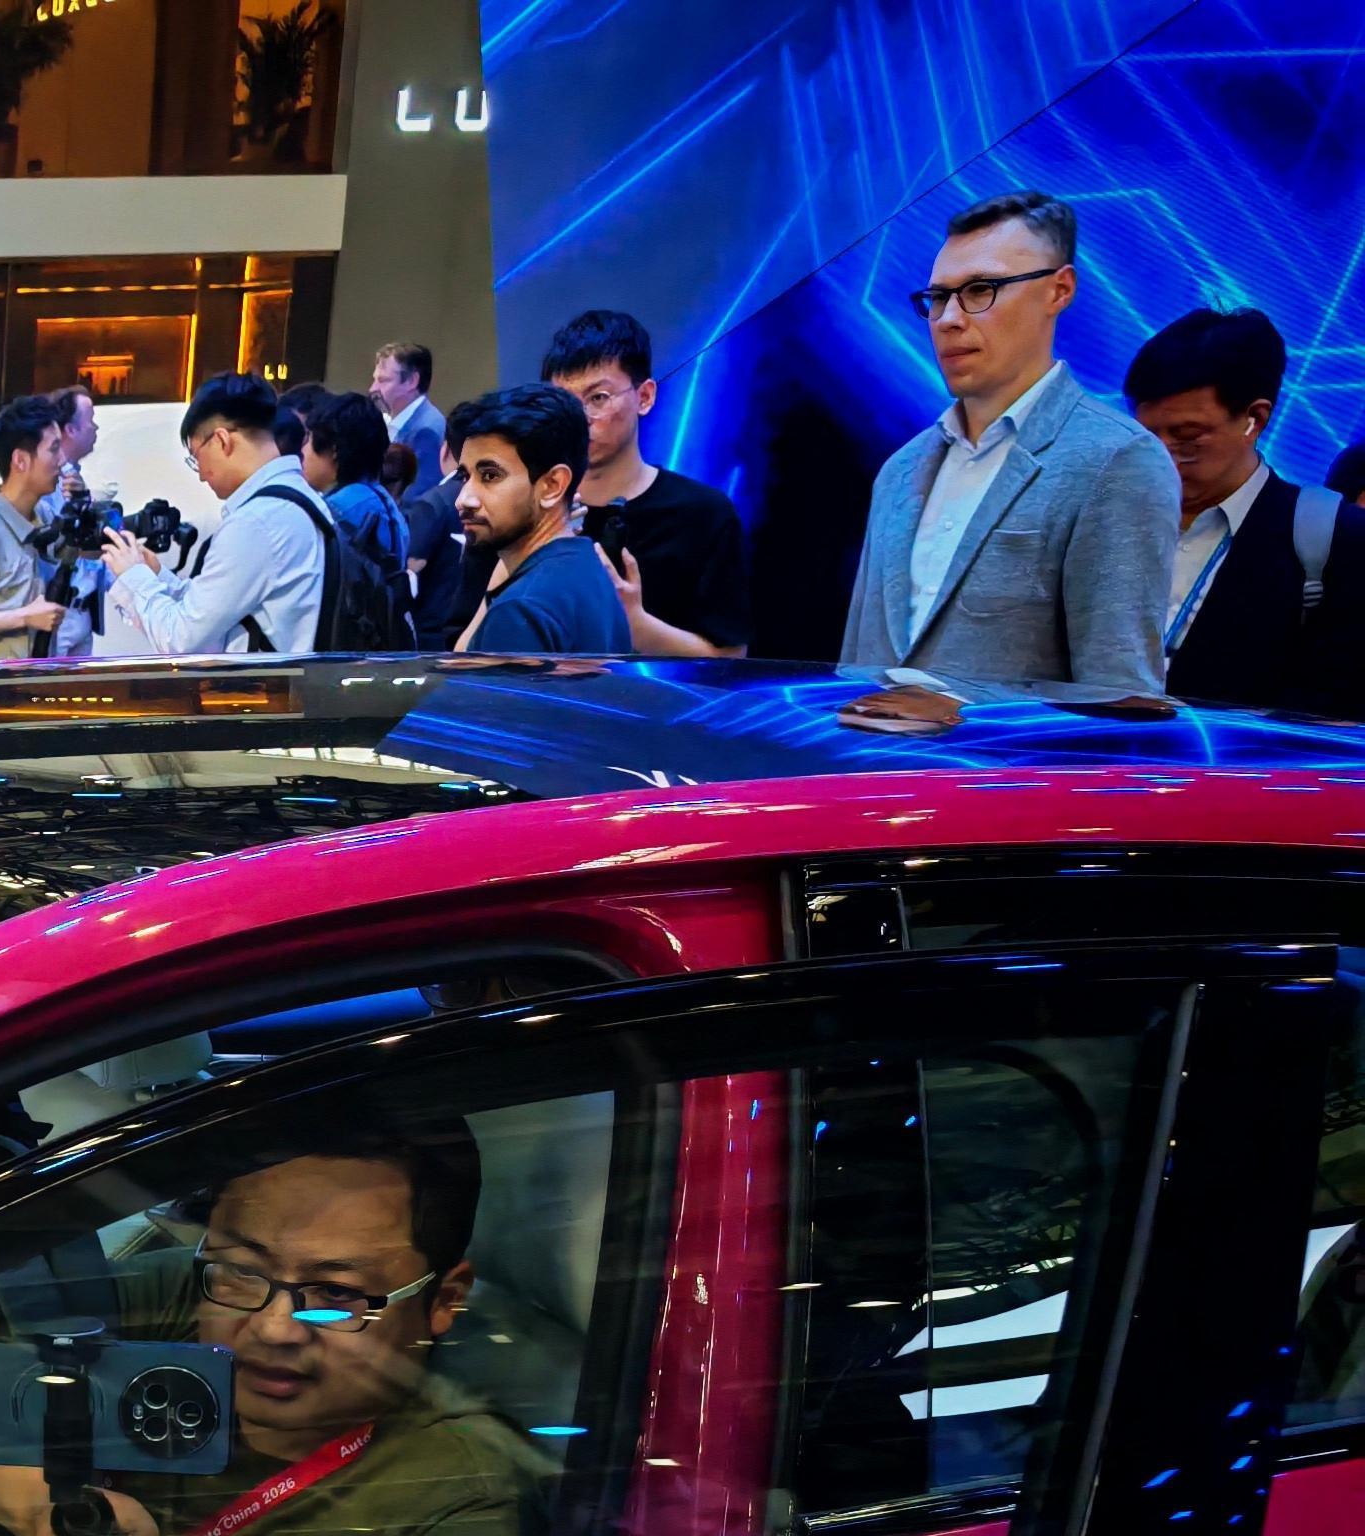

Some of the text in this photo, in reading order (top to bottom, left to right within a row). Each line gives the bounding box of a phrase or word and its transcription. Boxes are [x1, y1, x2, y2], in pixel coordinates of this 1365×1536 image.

[340, 1434, 372, 1458] Auto
[222, 1502, 262, 1530] China
[262, 1477, 296, 1505] 2026
